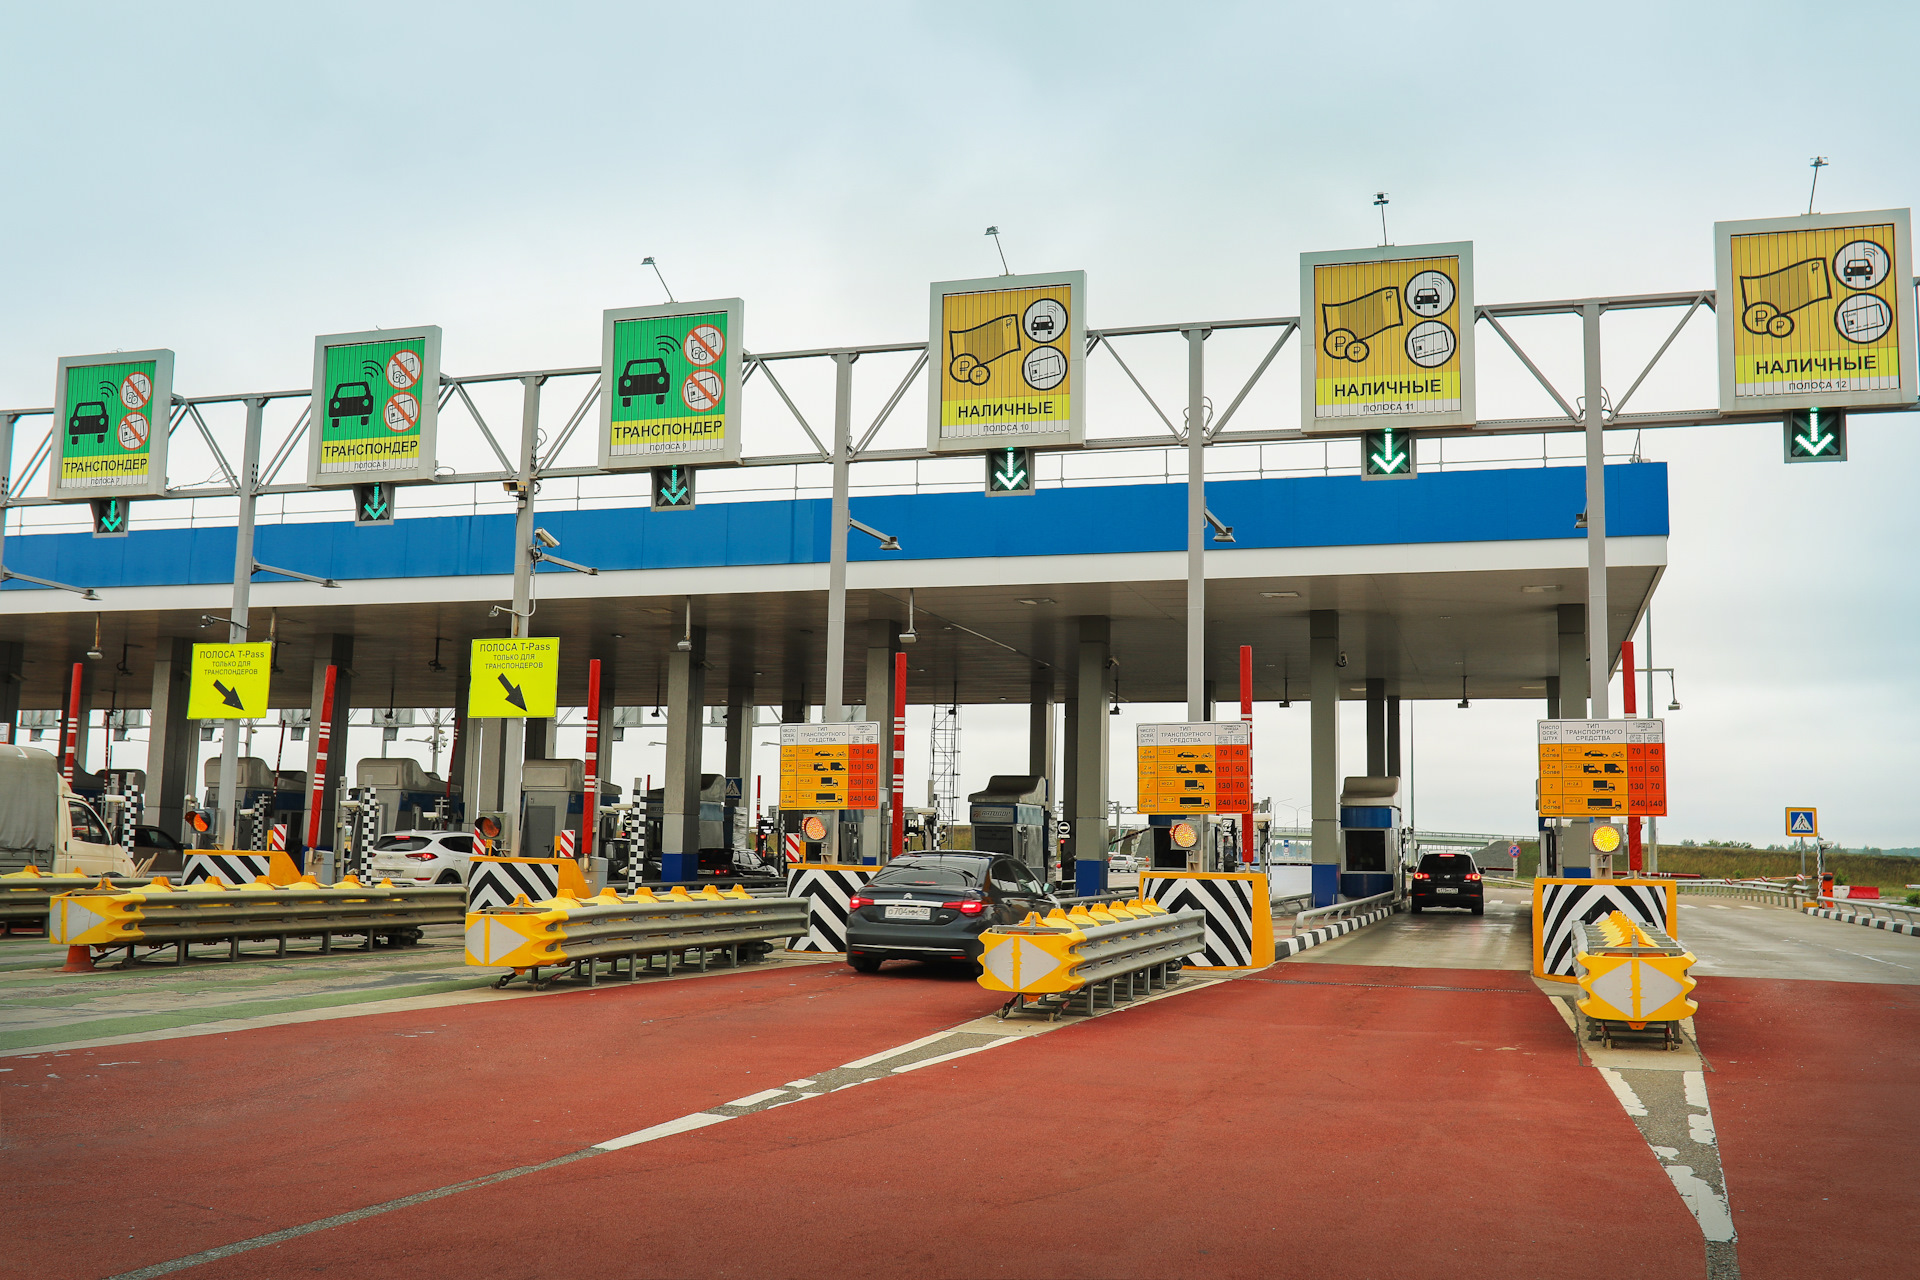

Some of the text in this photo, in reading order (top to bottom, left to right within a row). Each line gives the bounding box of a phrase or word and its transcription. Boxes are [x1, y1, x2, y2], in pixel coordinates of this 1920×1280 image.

[1756, 355, 1877, 375] НАЛИЧНЫЕ
[1335, 379, 1441, 397] НАЛИЧНЫЕ
[1789, 380, 1847, 391] ПОЛОСА 12
[958, 401, 1053, 418] НАЛИЧНЫЕ
[1363, 403, 1414, 412] ПОЛОСА 11
[614, 420, 722, 439] ТРАНСПОНДЕР
[983, 423, 1029, 432] ПОЛОСА 10
[324, 440, 418, 457] ТРАНСПОНДЕР
[650, 443, 681, 451] ПОЛОСА
[64, 458, 147, 473] ТРАНСПОНДЕР
[355, 461, 381, 469] ПОЛОСА
[480, 642, 551, 652] ПОЛОСА T-Pass
[200, 650, 265, 659] ПОЛОСА T-Pass
